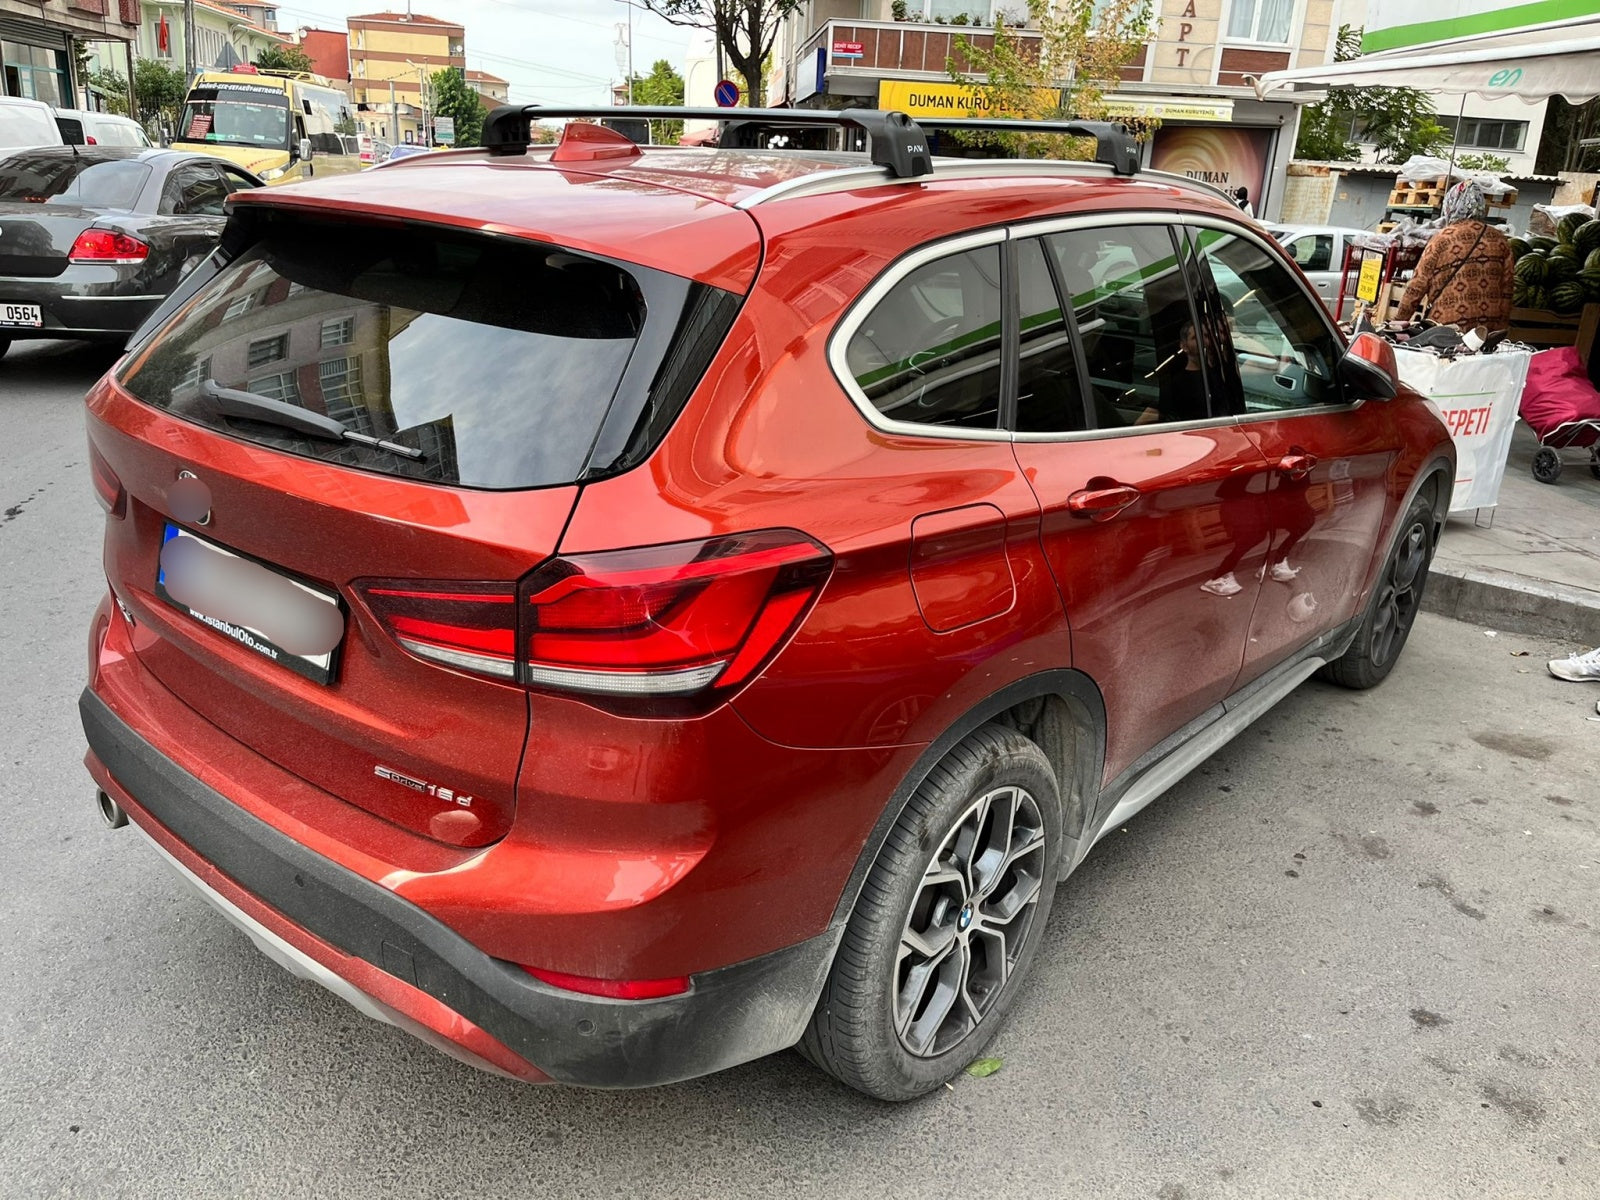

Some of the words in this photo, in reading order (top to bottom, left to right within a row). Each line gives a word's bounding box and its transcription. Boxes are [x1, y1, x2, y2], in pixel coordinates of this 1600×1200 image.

[1176, 0, 1196, 67] APT
[909, 94, 954, 109] DUMAN
[906, 145, 924, 153] PAW
[1186, 170, 1229, 184] DUMAN
[6, 306, 39, 321] 0564
